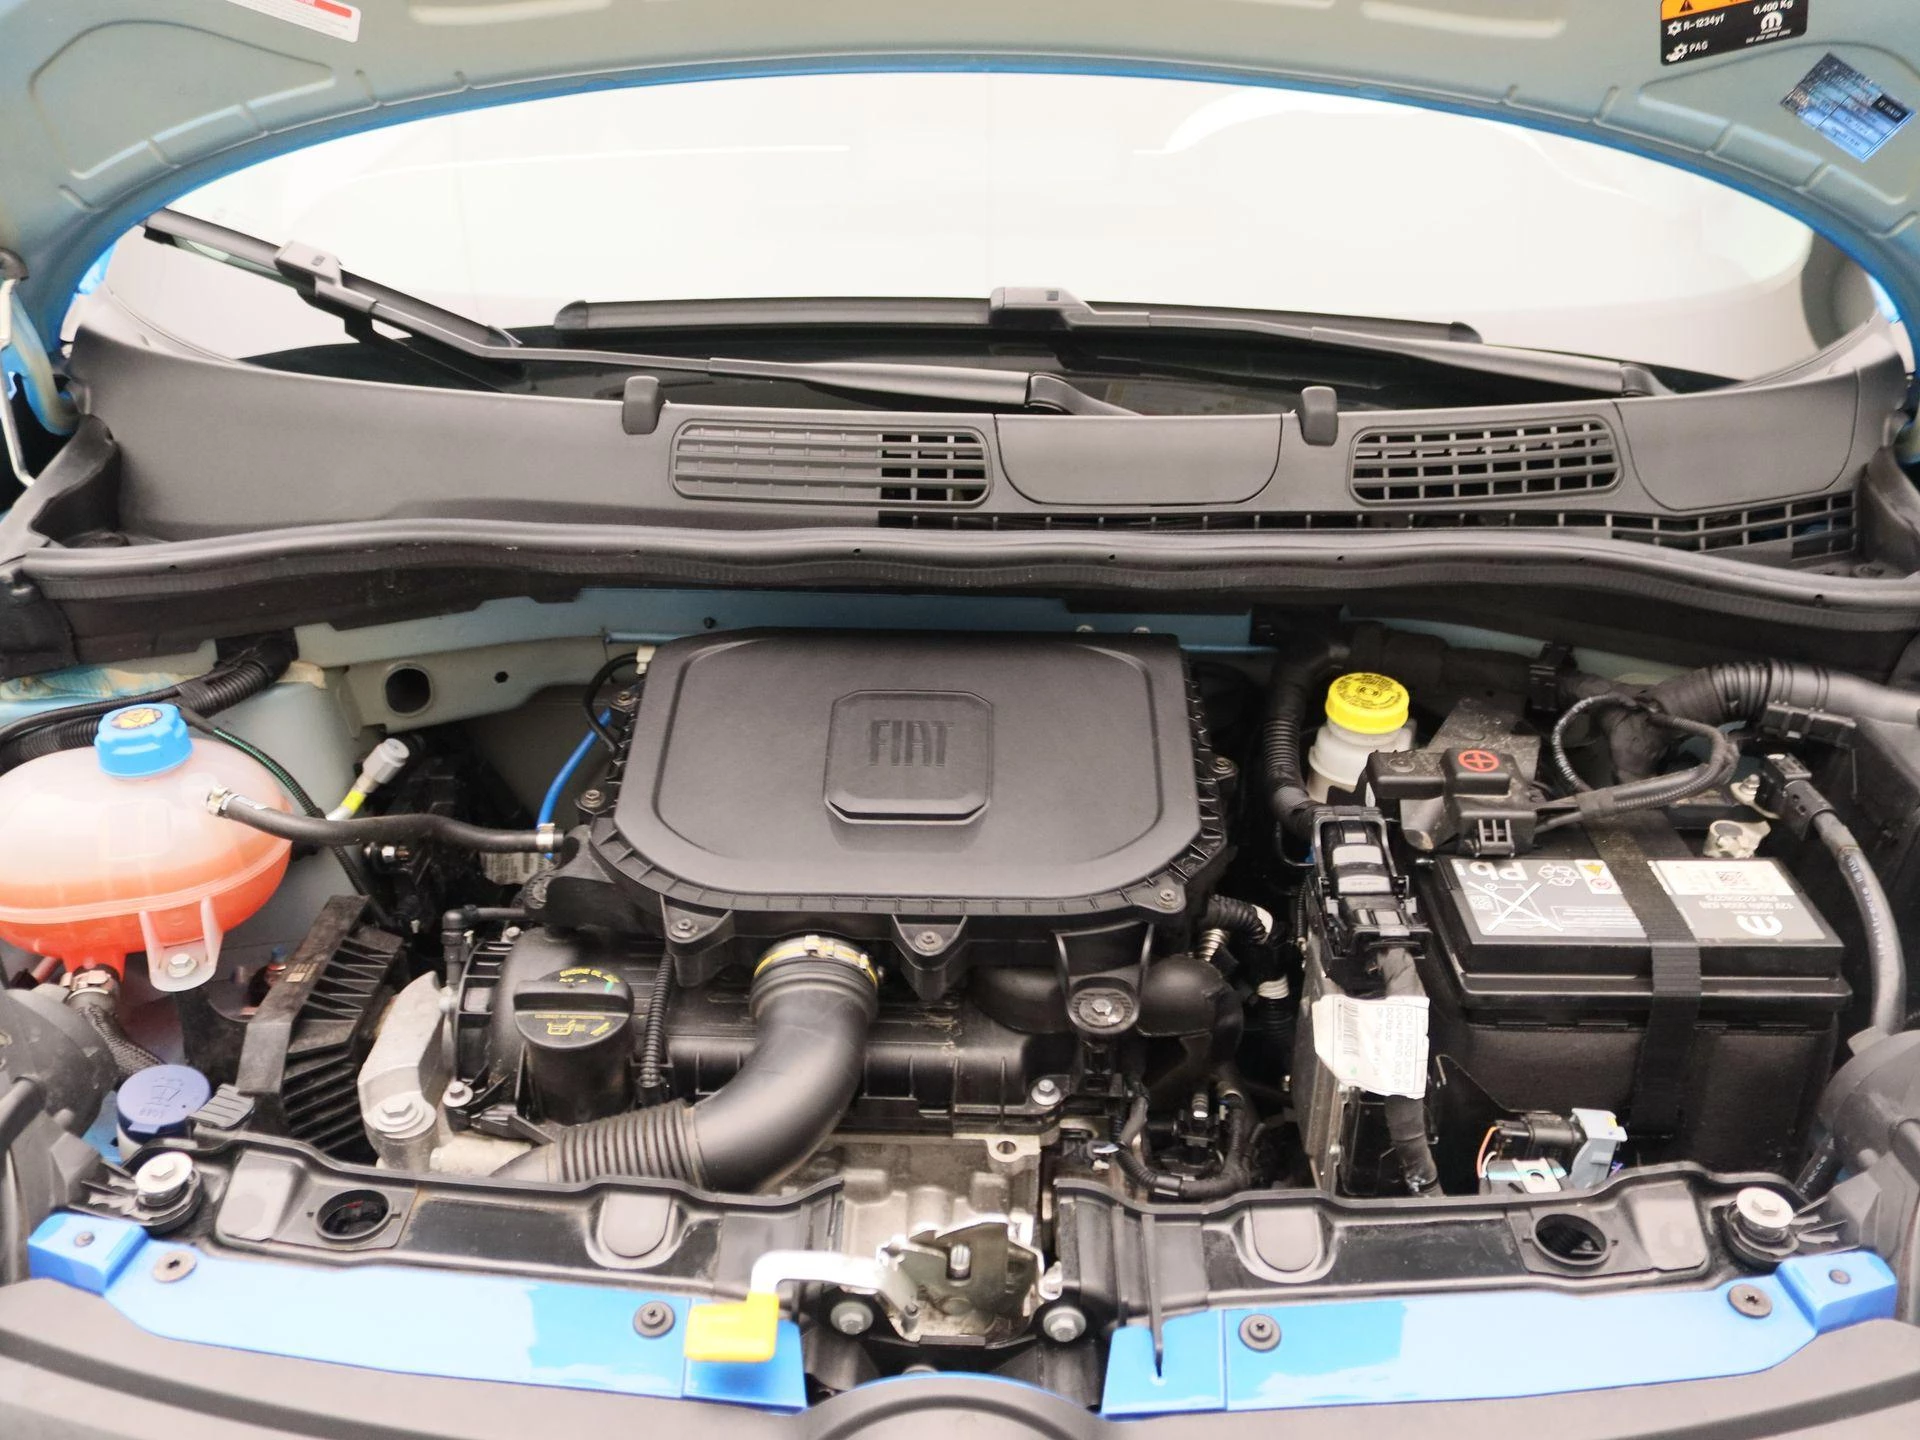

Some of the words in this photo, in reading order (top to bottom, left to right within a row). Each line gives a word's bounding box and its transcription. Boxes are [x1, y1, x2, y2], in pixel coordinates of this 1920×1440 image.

[1753, 1, 1779, 15] 0.400
[1689, 40, 1709, 53] PAG
[869, 719, 954, 767] FIAT
[1471, 860, 1528, 882] Pb
